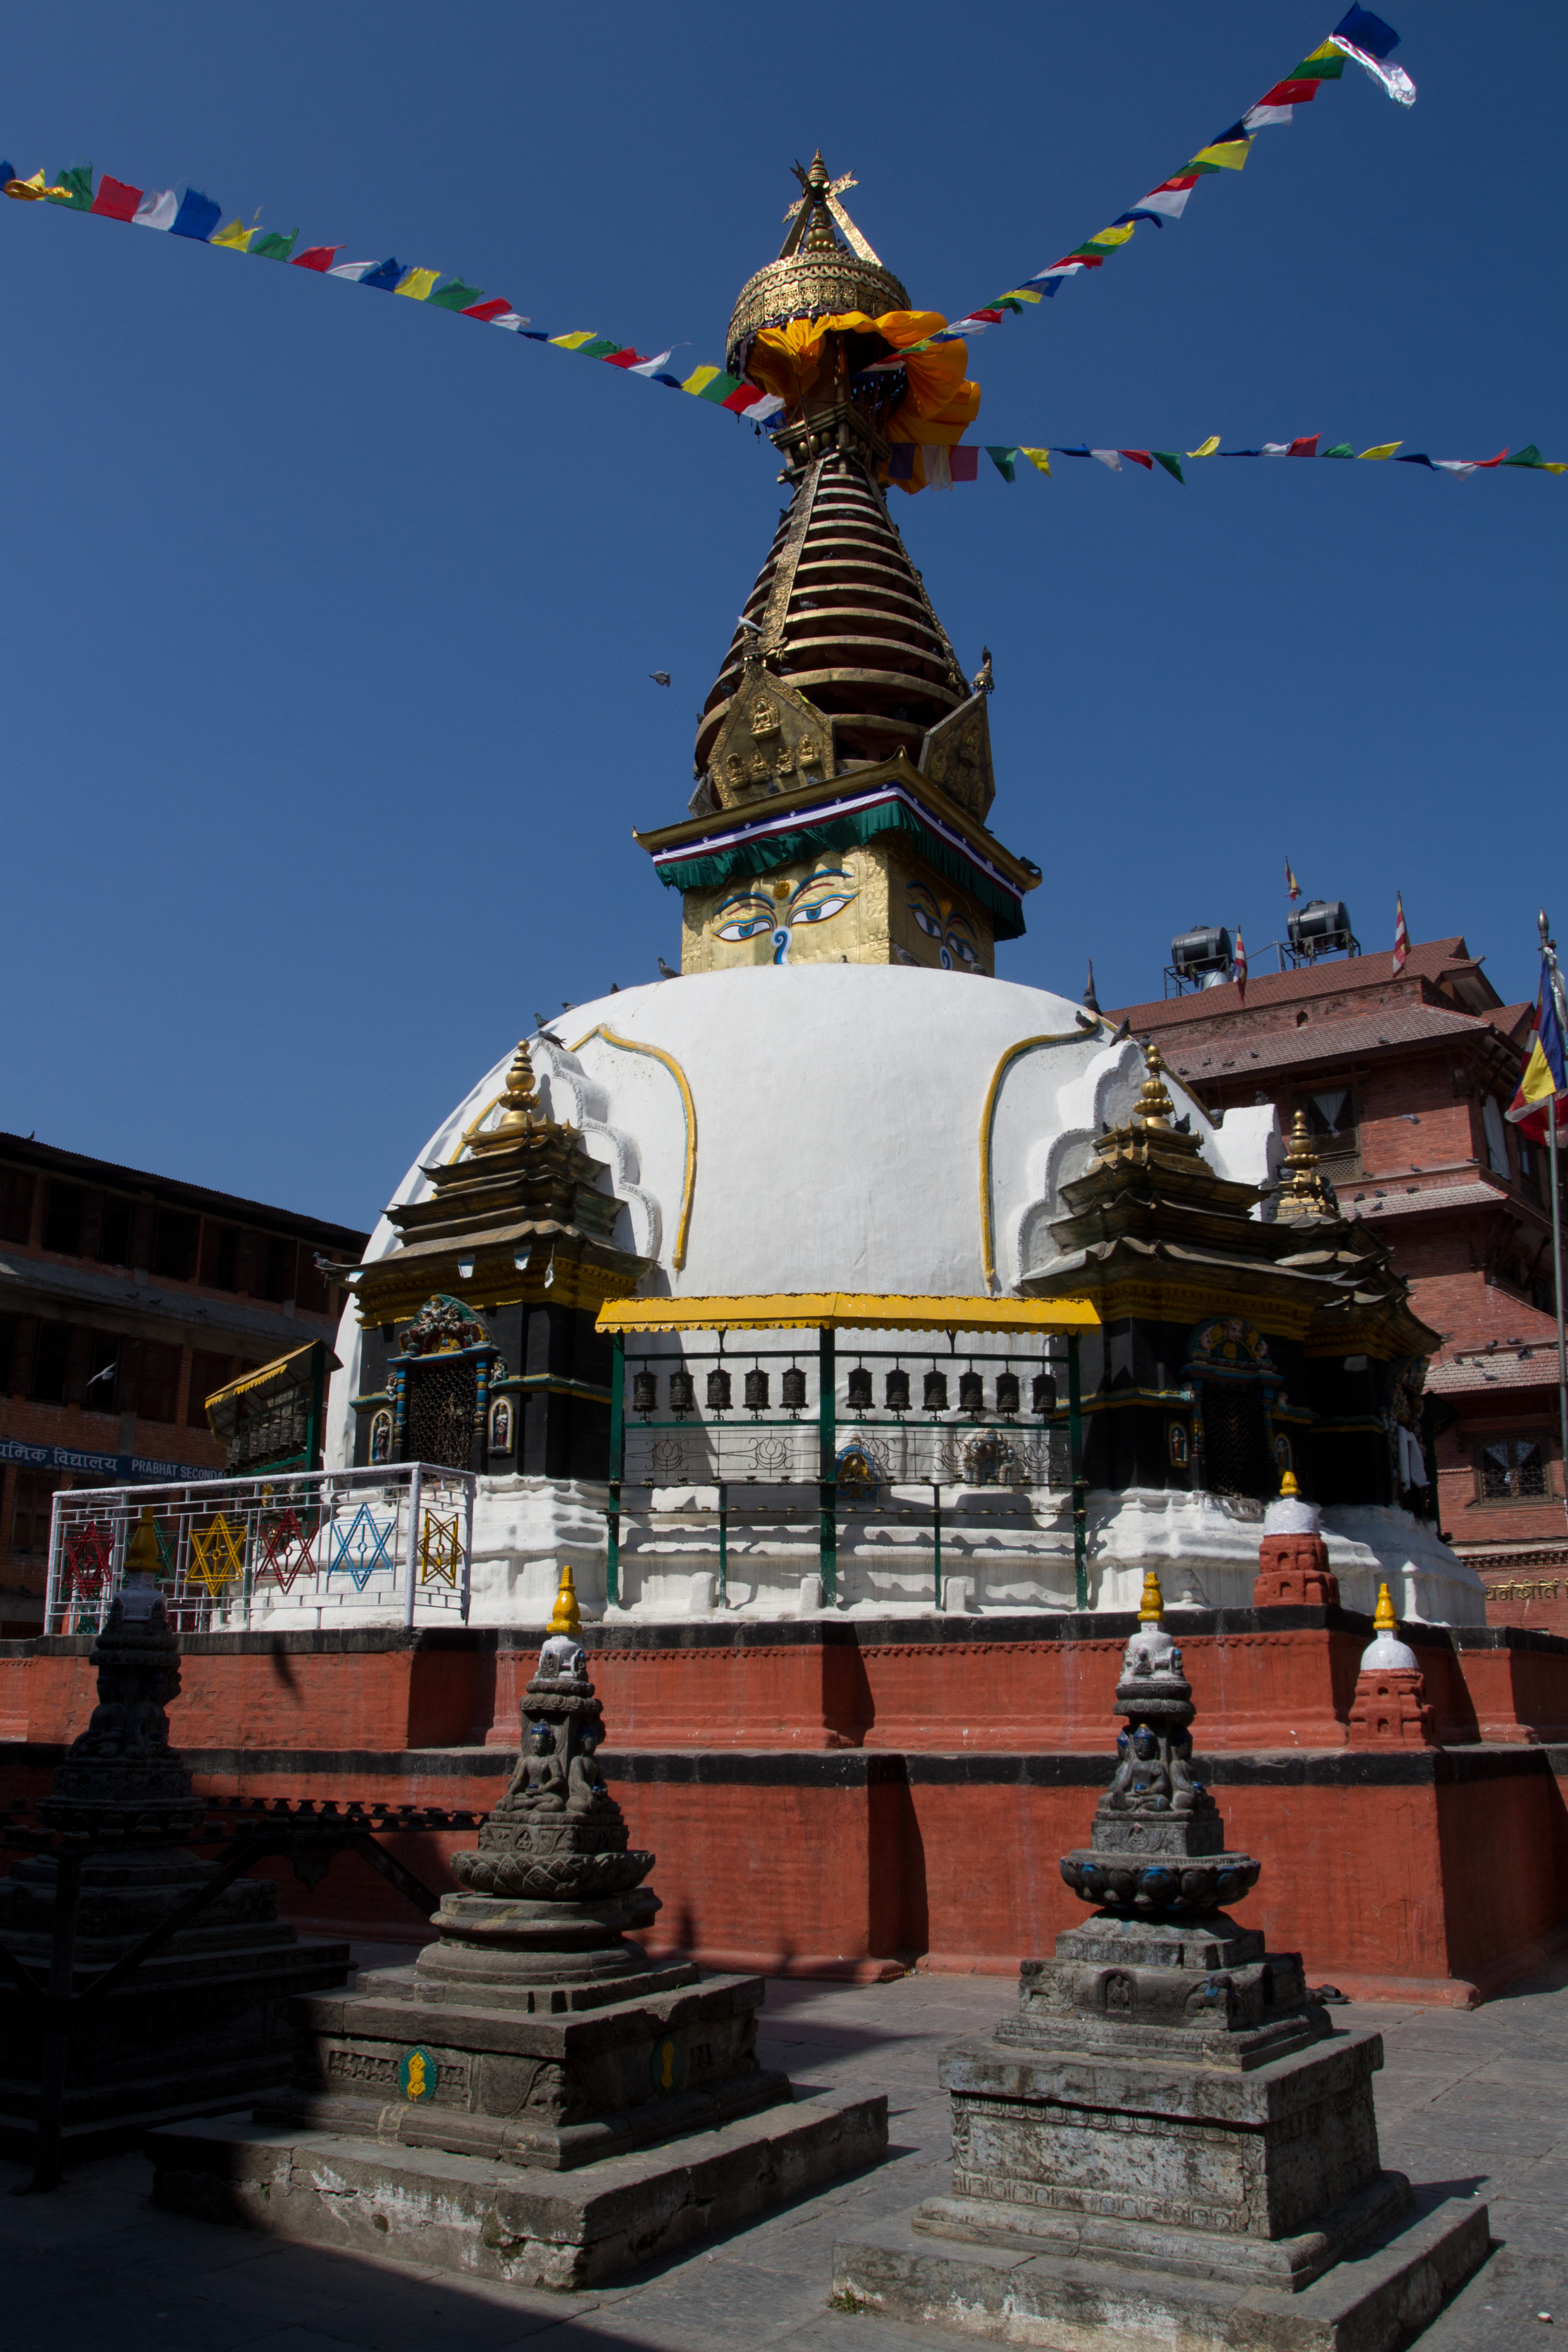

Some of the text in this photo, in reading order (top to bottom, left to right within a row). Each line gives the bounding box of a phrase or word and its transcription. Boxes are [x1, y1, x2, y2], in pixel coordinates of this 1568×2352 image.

[53, 1447, 118, 1471] विद्यालय
[132, 1459, 226, 1480] PRABHAT SECONDA
